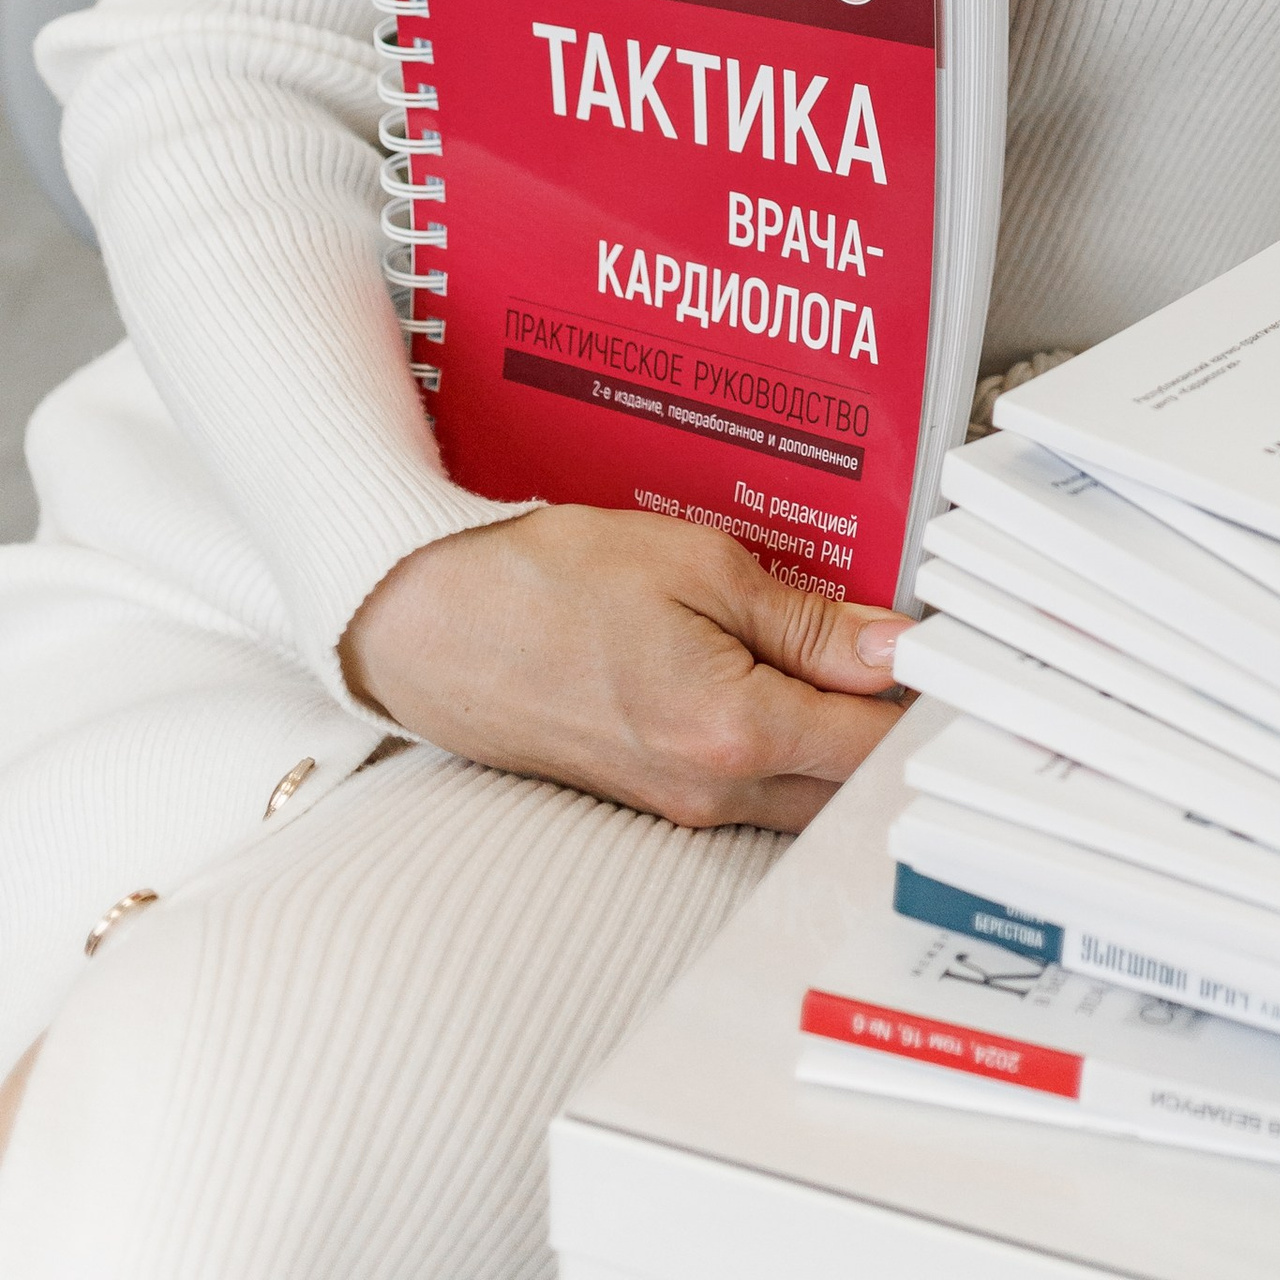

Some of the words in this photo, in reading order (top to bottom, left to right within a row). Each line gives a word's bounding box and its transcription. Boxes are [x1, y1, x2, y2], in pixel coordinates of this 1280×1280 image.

[532, 22, 889, 185] ТАКТИКА
[728, 191, 884, 277] ВРАЧА-
[598, 240, 880, 365] КАРДИОЛОГА
[505, 309, 684, 387] ПРАКТИЧЕСКОЕ
[694, 359, 870, 437] РУКОВОДСТВО
[592, 380, 612, 400] 2-е
[614, 391, 664, 418] издание,
[668, 405, 765, 444] переработанное
[768, 434, 776, 447] и
[778, 436, 859, 471] дополненное
[634, 488, 815, 556] члена-корреспондента
[821, 541, 853, 571] РАН
[734, 481, 765, 512] Под
[769, 497, 858, 538] редакцией
[770, 558, 846, 602] Кобалава
[974, 912, 1043, 949] БЕРЕСТОВА
[1150, 1089, 1262, 1132] БЕЛАРУСИ
